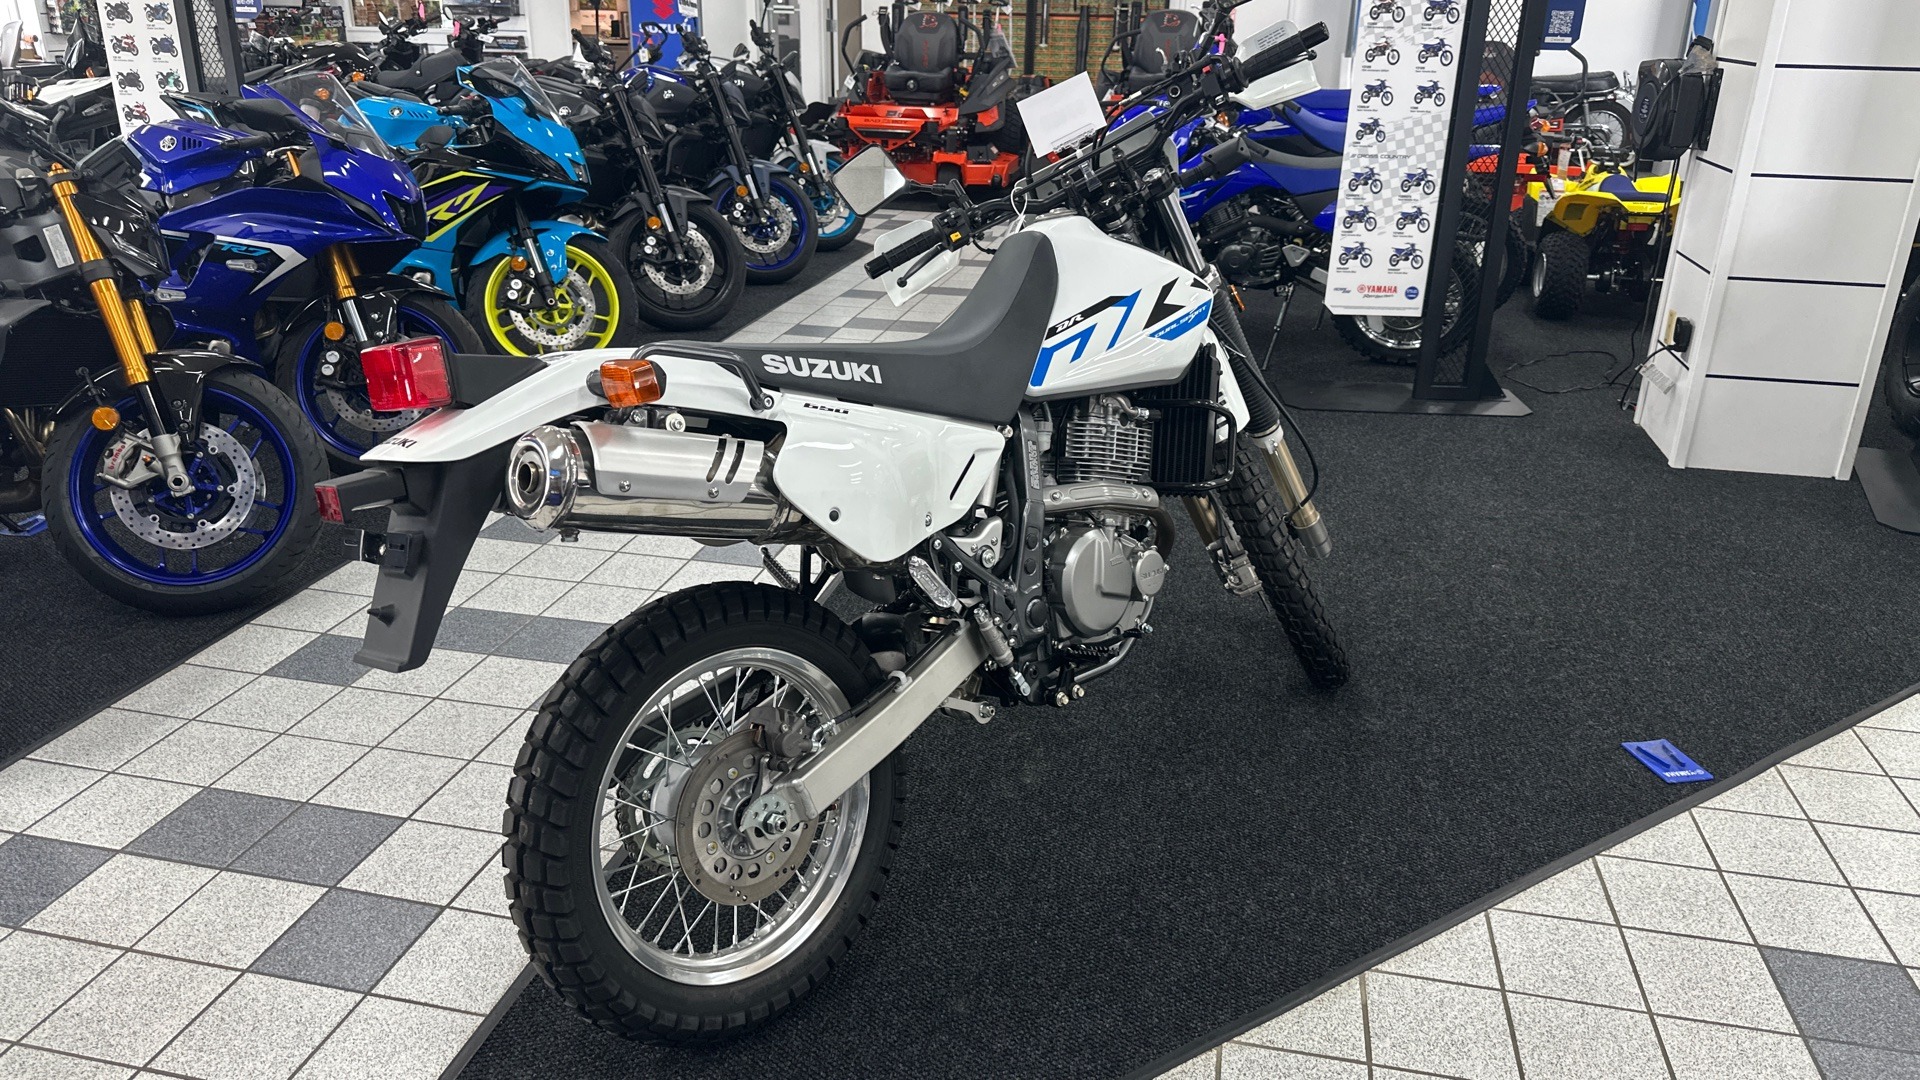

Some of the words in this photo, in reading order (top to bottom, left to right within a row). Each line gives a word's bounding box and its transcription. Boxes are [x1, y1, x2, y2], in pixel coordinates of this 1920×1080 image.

[639, 23, 692, 34] SUZUI
[1367, 285, 1398, 294] YAMAHA
[1055, 313, 1085, 334] DR
[1154, 322, 1180, 339] DUAL
[1180, 304, 1208, 324] SPORT
[760, 353, 883, 385] SUZUKI
[108, 444, 126, 470] brembo
